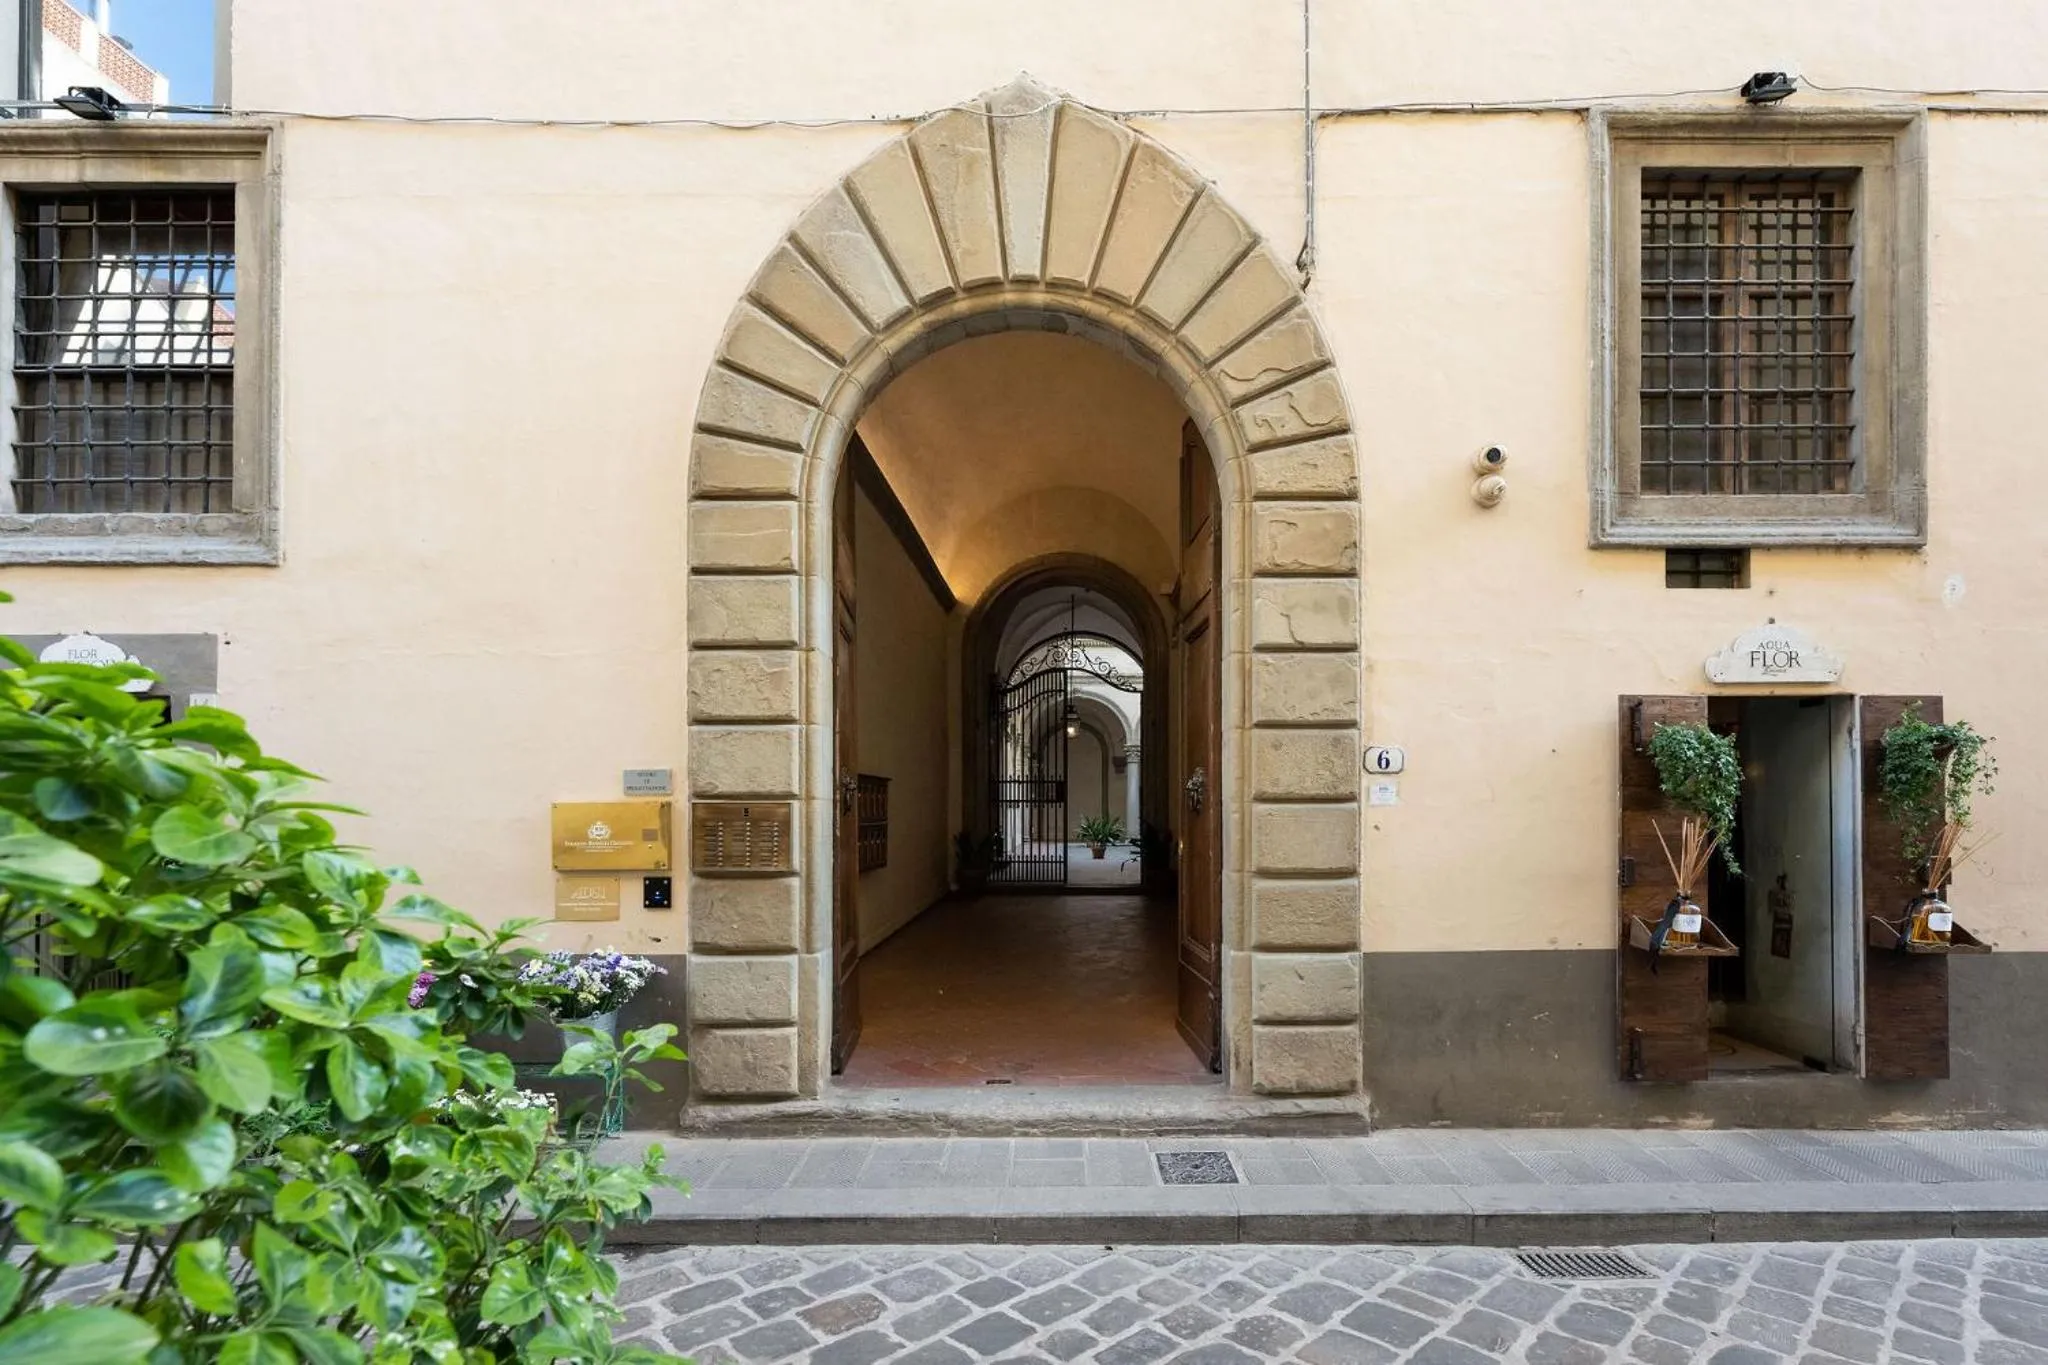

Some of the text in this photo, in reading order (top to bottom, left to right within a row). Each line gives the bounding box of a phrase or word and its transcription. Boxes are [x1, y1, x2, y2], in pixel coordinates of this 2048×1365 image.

[67, 647, 98, 659] FLOR
[1758, 640, 1790, 651] AQUA
[1750, 650, 1802, 668] FLOR
[1377, 749, 1391, 770] 6
